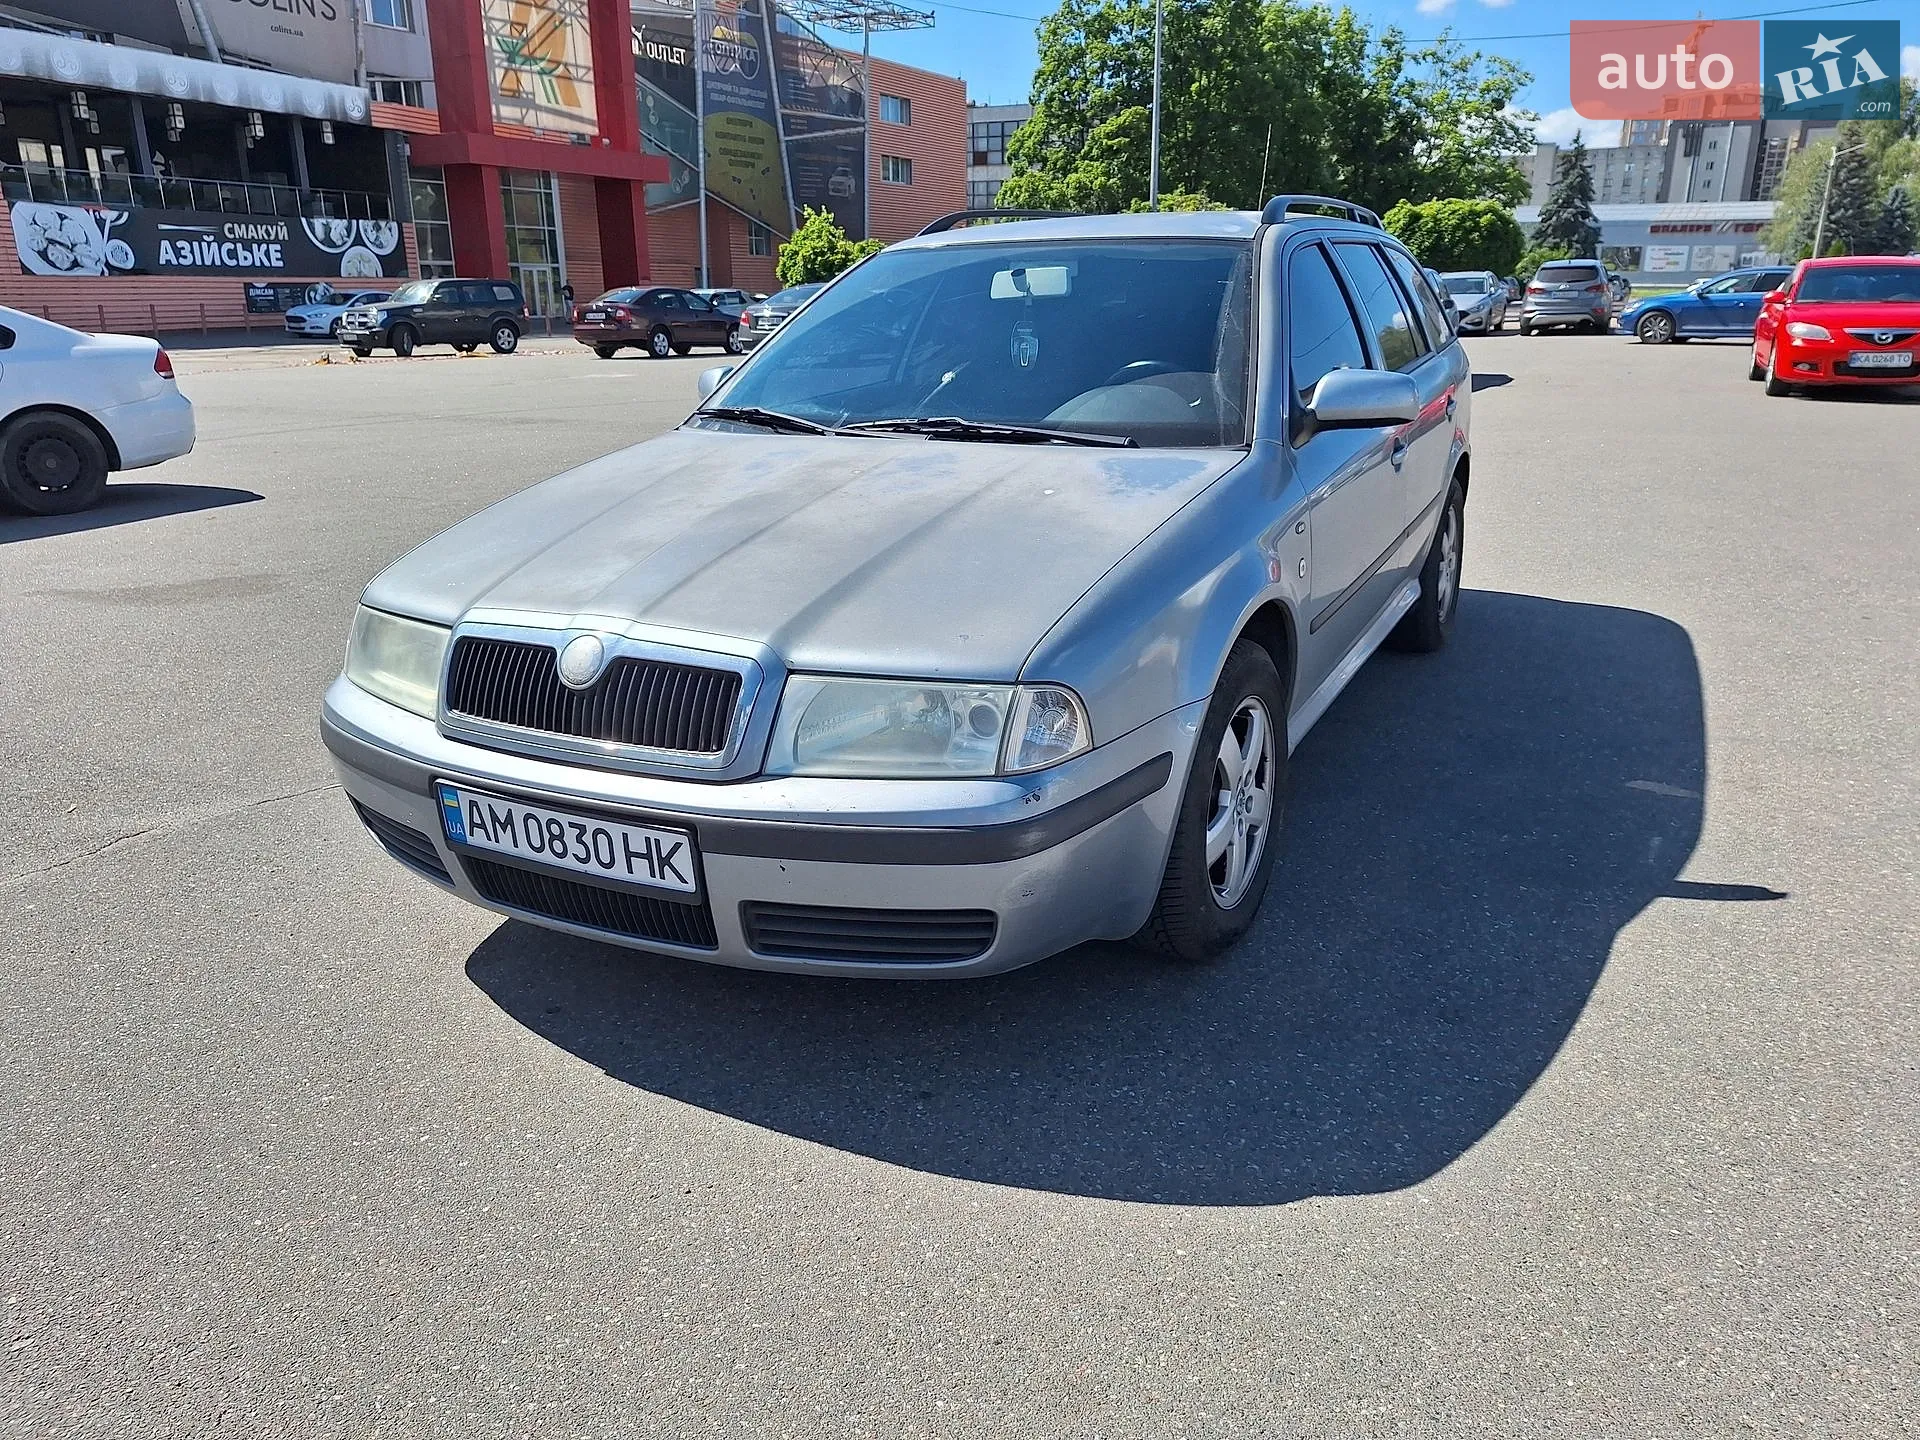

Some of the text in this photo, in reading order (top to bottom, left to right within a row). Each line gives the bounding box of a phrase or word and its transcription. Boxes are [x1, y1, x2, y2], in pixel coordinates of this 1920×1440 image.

[270, 24, 304, 37] colins.ua
[646, 41, 686, 65] OUTLET
[223, 221, 289, 241] СМАКУЙ
[159, 234, 284, 268] АЗІЙСЬКЕ
[449, 821, 464, 836] UA
